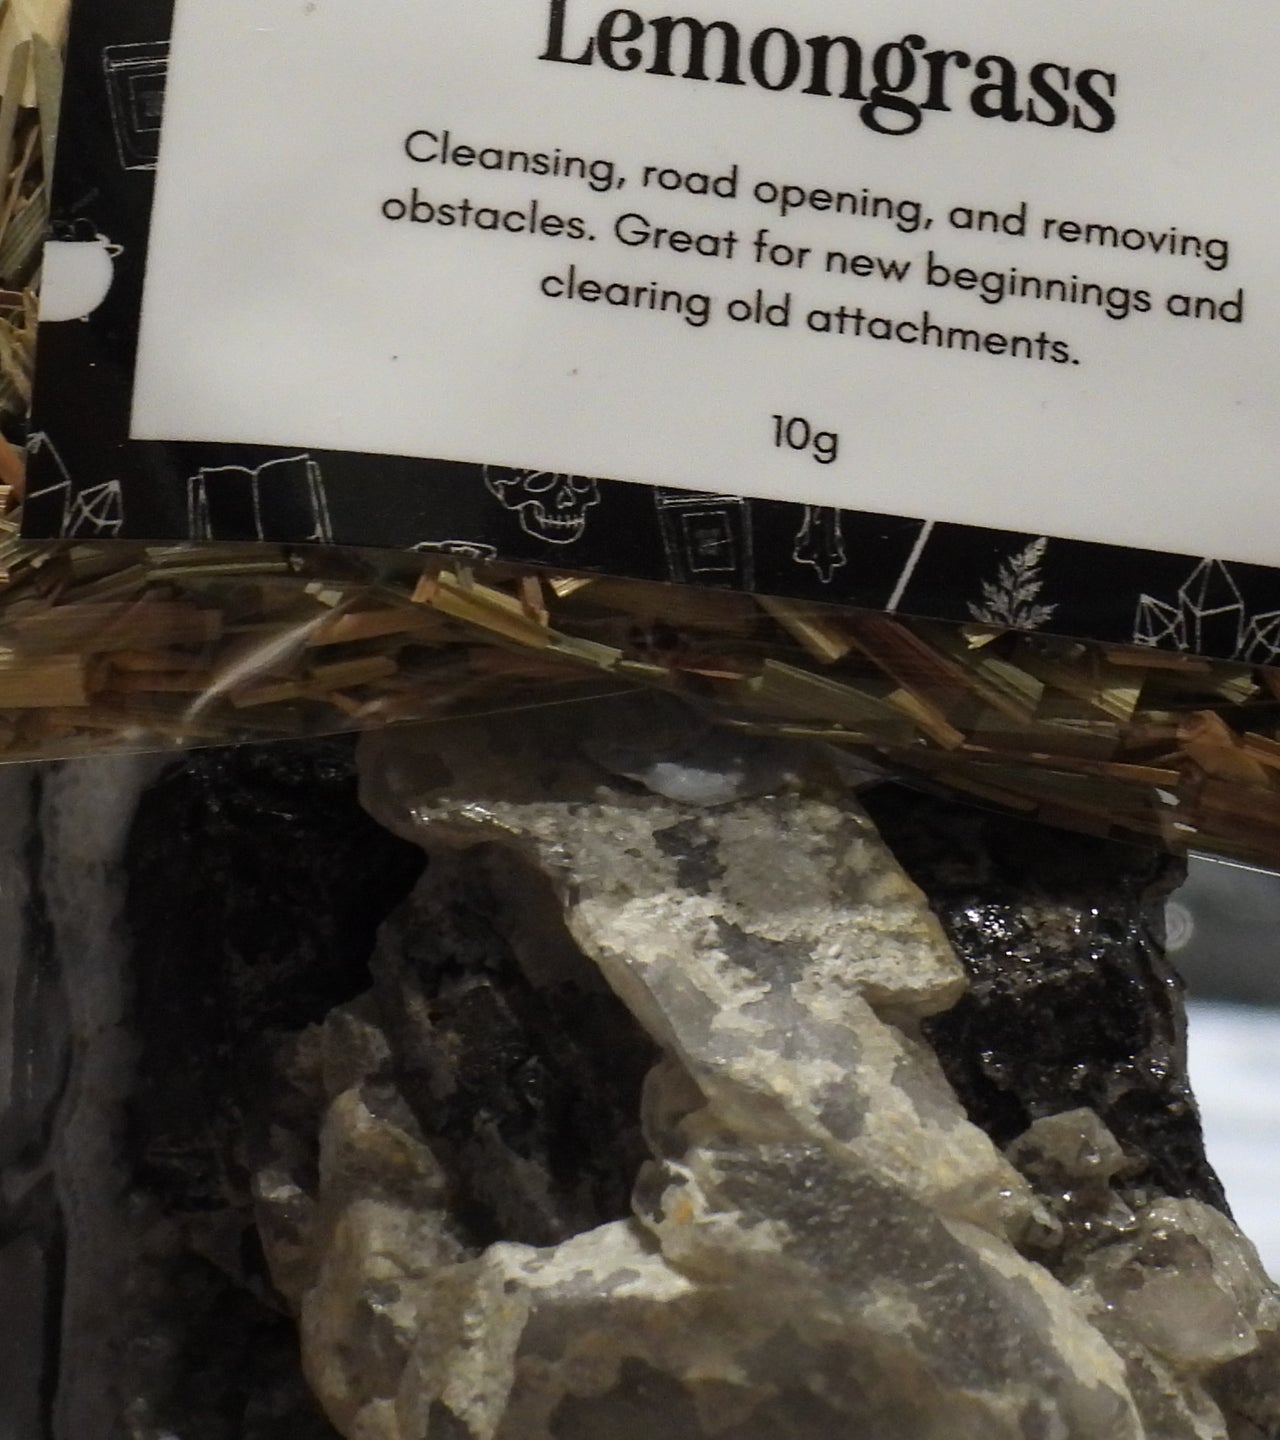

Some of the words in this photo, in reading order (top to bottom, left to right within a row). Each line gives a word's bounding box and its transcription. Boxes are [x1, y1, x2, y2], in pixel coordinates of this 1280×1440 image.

[380, 187, 597, 242] obstacles.
[613, 212, 740, 260] Great
[752, 228, 813, 270] for
[824, 251, 912, 283] new
[925, 249, 1153, 321] beginnings
[1165, 287, 1245, 324] and
[403, 129, 627, 193] Cleansing,
[641, 163, 739, 200] road
[752, 181, 934, 234] opening,
[947, 201, 1028, 238] and
[1042, 218, 1230, 272] removing
[539, 263, 712, 328] clearing
[726, 288, 792, 328] old
[805, 305, 1081, 366] attachments.
[771, 414, 840, 465] 10g
